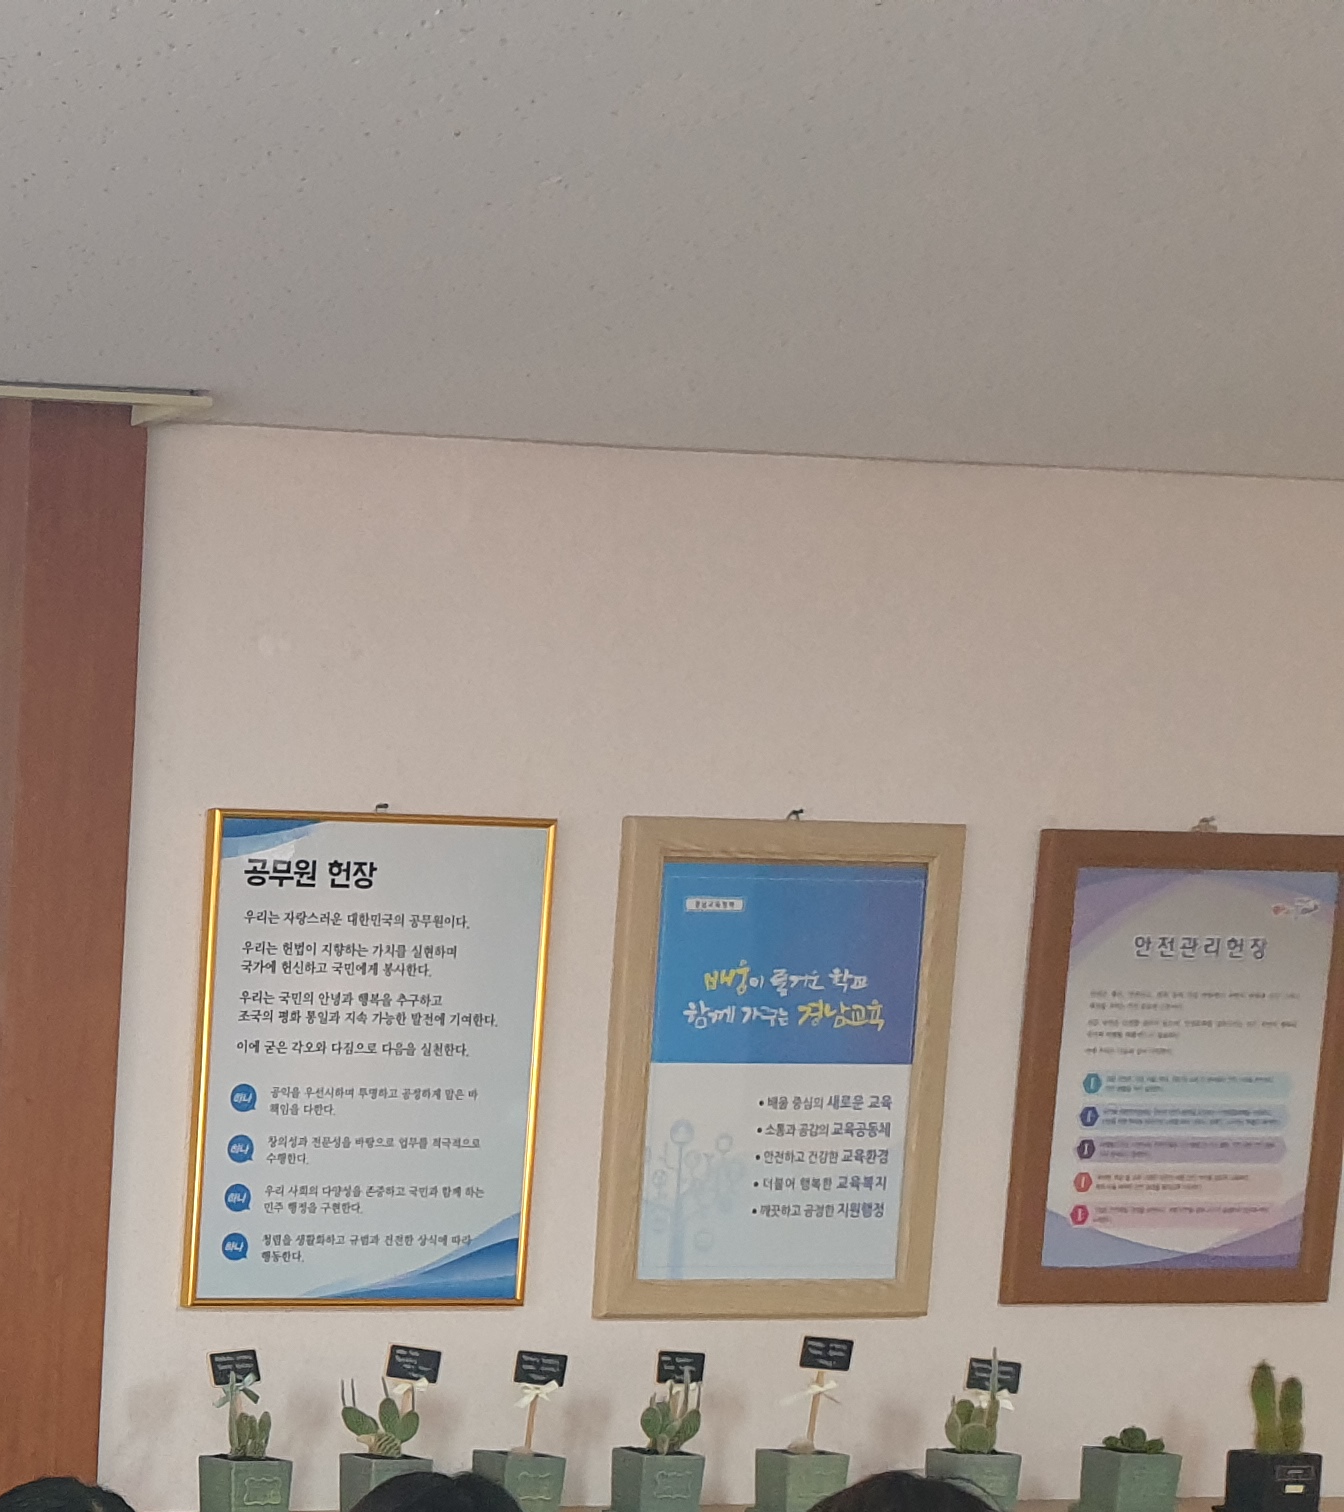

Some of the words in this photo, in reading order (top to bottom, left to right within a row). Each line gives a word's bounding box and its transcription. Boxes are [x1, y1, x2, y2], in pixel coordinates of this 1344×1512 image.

[244, 858, 317, 888] 공무원
[328, 859, 378, 889] 헌장
[244, 910, 280, 925] 우리는
[283, 910, 343, 926] 자랑스러운
[347, 912, 404, 927] 대한민국의
[409, 914, 470, 929] 공무원이다.
[242, 941, 278, 955] 우리는
[283, 941, 317, 956] 헌법이
[321, 942, 369, 957] 지향하는
[372, 943, 407, 959] 가치를
[412, 944, 458, 959] 실현하며
[1134, 936, 1268, 960] 안전관리헌장
[241, 960, 276, 974] 국가에
[282, 960, 328, 975] 헌신하고
[332, 961, 378, 976] 국민에게
[383, 962, 432, 978] 봉사한다.
[770, 968, 825, 997] 즐거운
[829, 967, 868, 993] 학교
[239, 990, 275, 1005] 우리는
[278, 991, 314, 1006] 국민의
[318, 991, 354, 1006] 안녕과
[358, 992, 392, 1007] 행복을
[396, 993, 442, 1007] 추구하고
[238, 1009, 273, 1023] 조국의
[278, 1010, 301, 1024] 평화
[305, 1010, 340, 1025] 통일과
[345, 1011, 368, 1025] 지속
[372, 1011, 407, 1026] 가능한
[411, 1012, 445, 1027] 발전에
[450, 1013, 498, 1028] 기여한다.
[683, 1000, 736, 1029] 함께
[741, 1006, 789, 1027] 가꾸는
[797, 999, 885, 1031] 경남교육
[236, 1039, 260, 1054] 이에
[264, 1040, 288, 1054] 굳은
[292, 1040, 327, 1055] 각오와
[332, 1041, 377, 1055] 다짐으로
[382, 1041, 416, 1056] 다음을
[421, 1042, 469, 1057] 실천한다.
[764, 1123, 796, 1137] 소통과
[798, 1123, 829, 1137] 공감의
[832, 1122, 891, 1138] 교육공동체
[764, 1150, 805, 1164] 안전하고
[808, 1150, 838, 1164] 건강한
[841, 1149, 889, 1164] 교육환경
